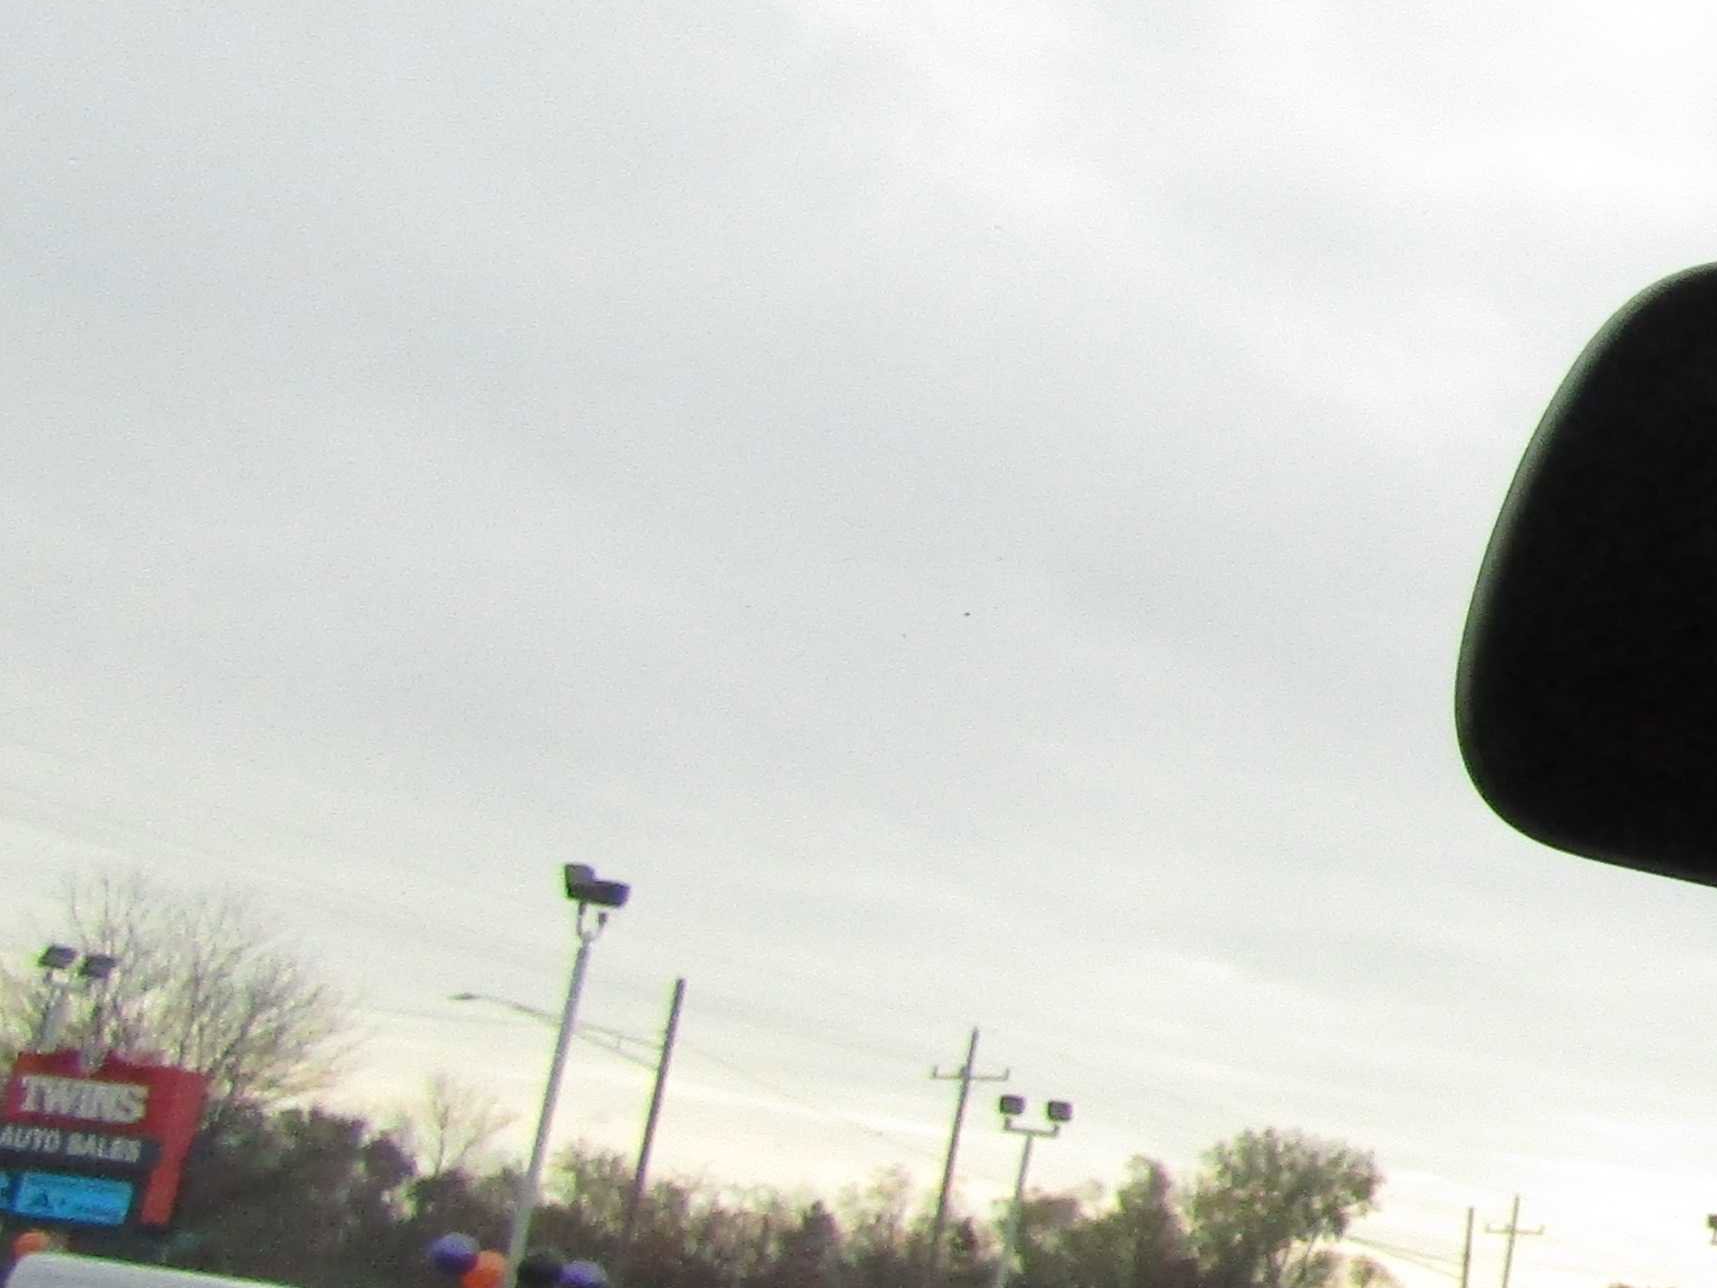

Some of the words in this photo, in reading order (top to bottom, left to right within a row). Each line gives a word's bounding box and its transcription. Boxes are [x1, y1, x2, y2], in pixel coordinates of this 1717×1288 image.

[22, 1075, 148, 1123] TWINS
[0, 1126, 60, 1152] AUTO
[67, 1133, 141, 1163] SALES
